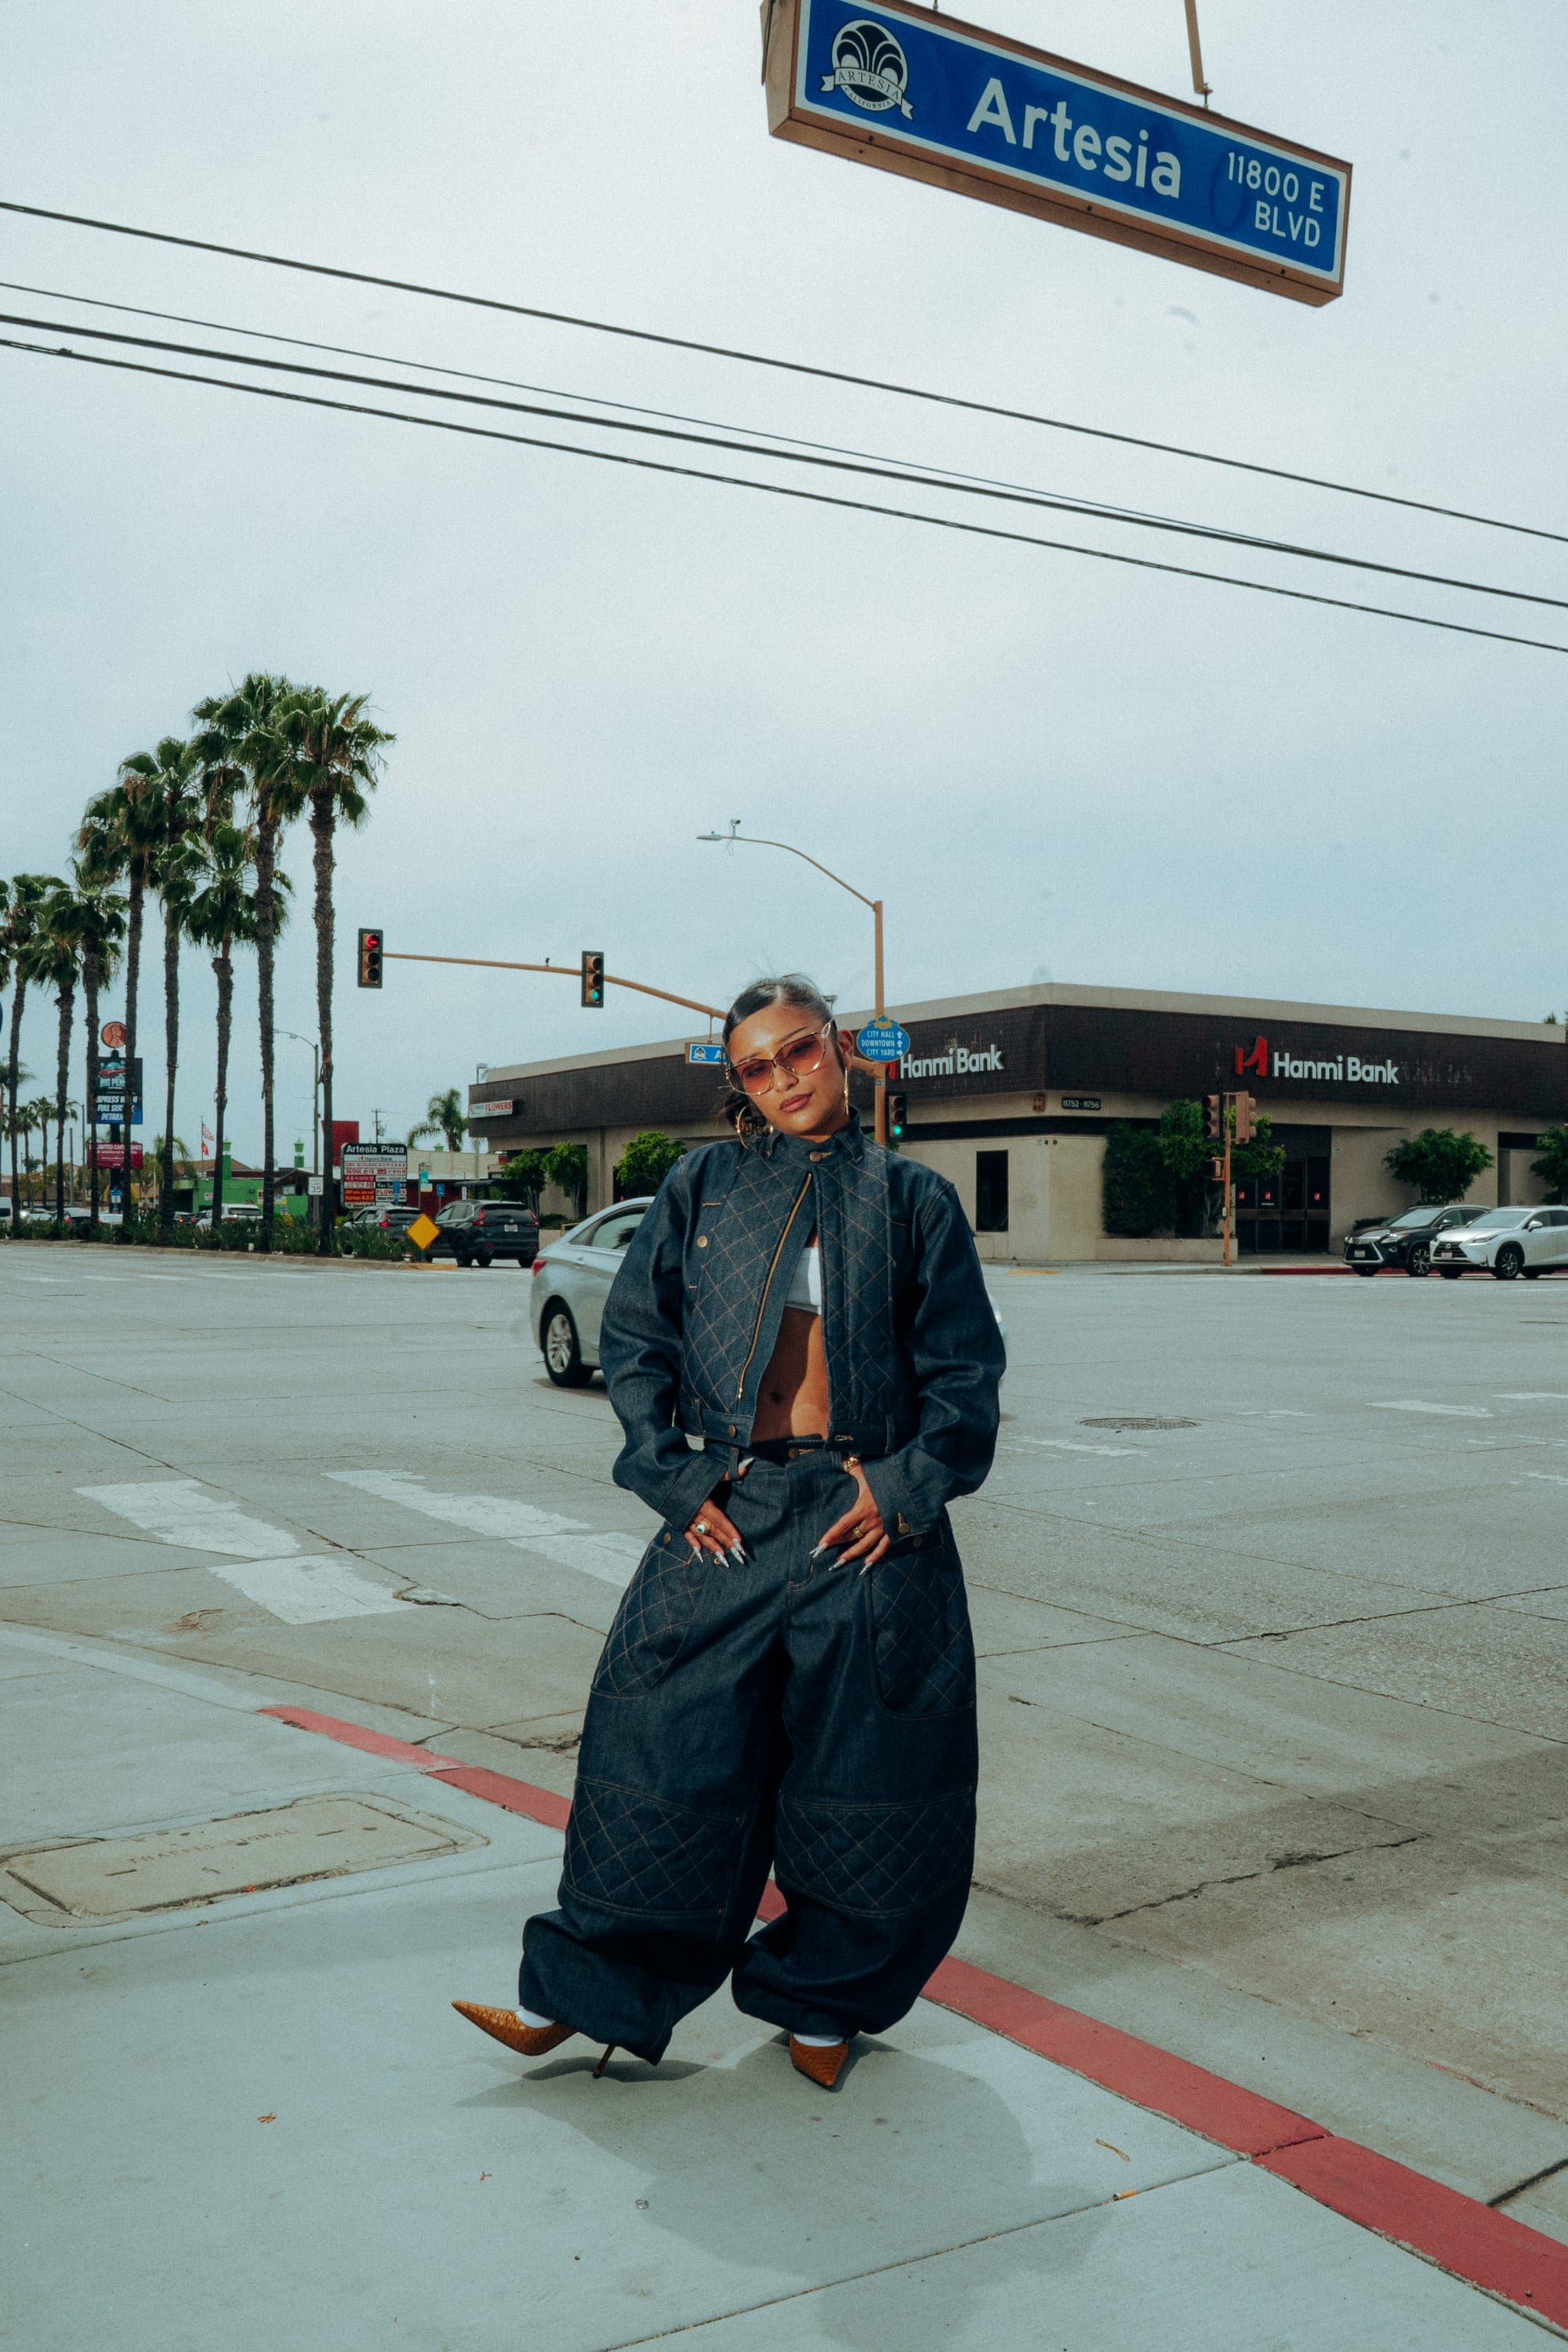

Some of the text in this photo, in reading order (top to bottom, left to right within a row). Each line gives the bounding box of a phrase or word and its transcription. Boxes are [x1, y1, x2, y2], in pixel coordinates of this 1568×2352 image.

[838, 71, 899, 101] ARTESIA
[844, 87, 892, 109] CALIFORNIA
[967, 77, 1181, 198] Artesia
[1229, 151, 1325, 212] 11800 E
[1255, 200, 1320, 247] BLVD
[900, 1044, 1004, 1080] Hanmi Bank
[1272, 1051, 1343, 1080] Hanmi
[1347, 1056, 1399, 1084] Bank
[485, 1102, 512, 1112] FLOWERS
